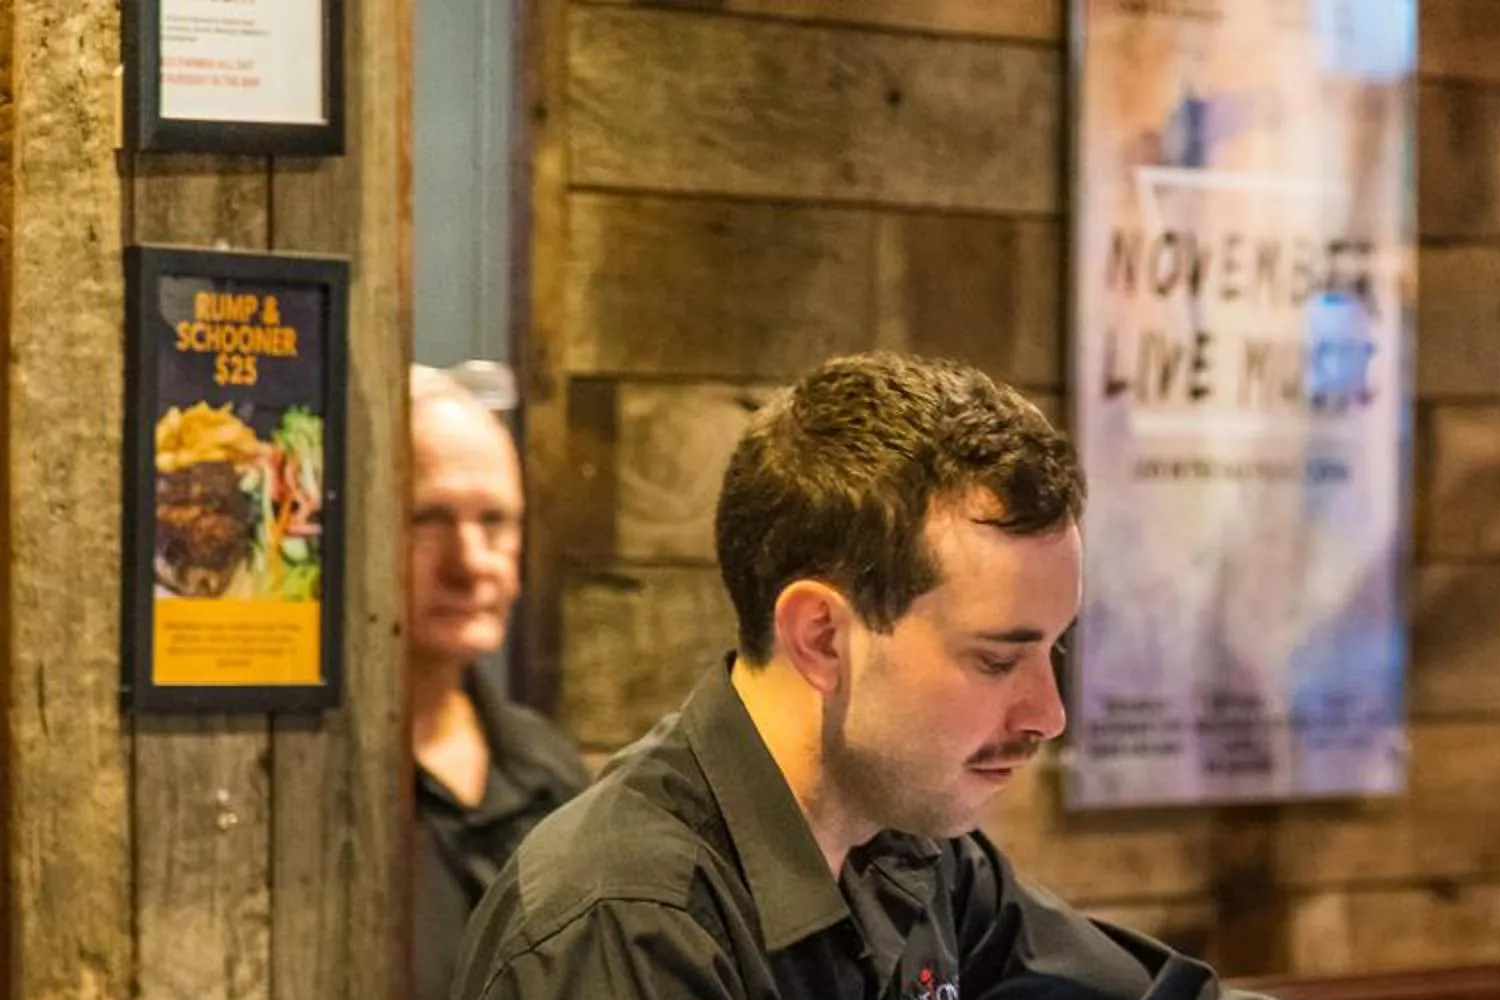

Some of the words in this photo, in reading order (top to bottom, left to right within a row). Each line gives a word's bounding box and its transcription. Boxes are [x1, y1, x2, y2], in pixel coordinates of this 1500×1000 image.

[194, 291, 258, 322] RUMP
[263, 294, 280, 325] &
[176, 319, 298, 356] SCHOONER
[213, 353, 257, 387] $25
[1101, 328, 1213, 408] LIVE
